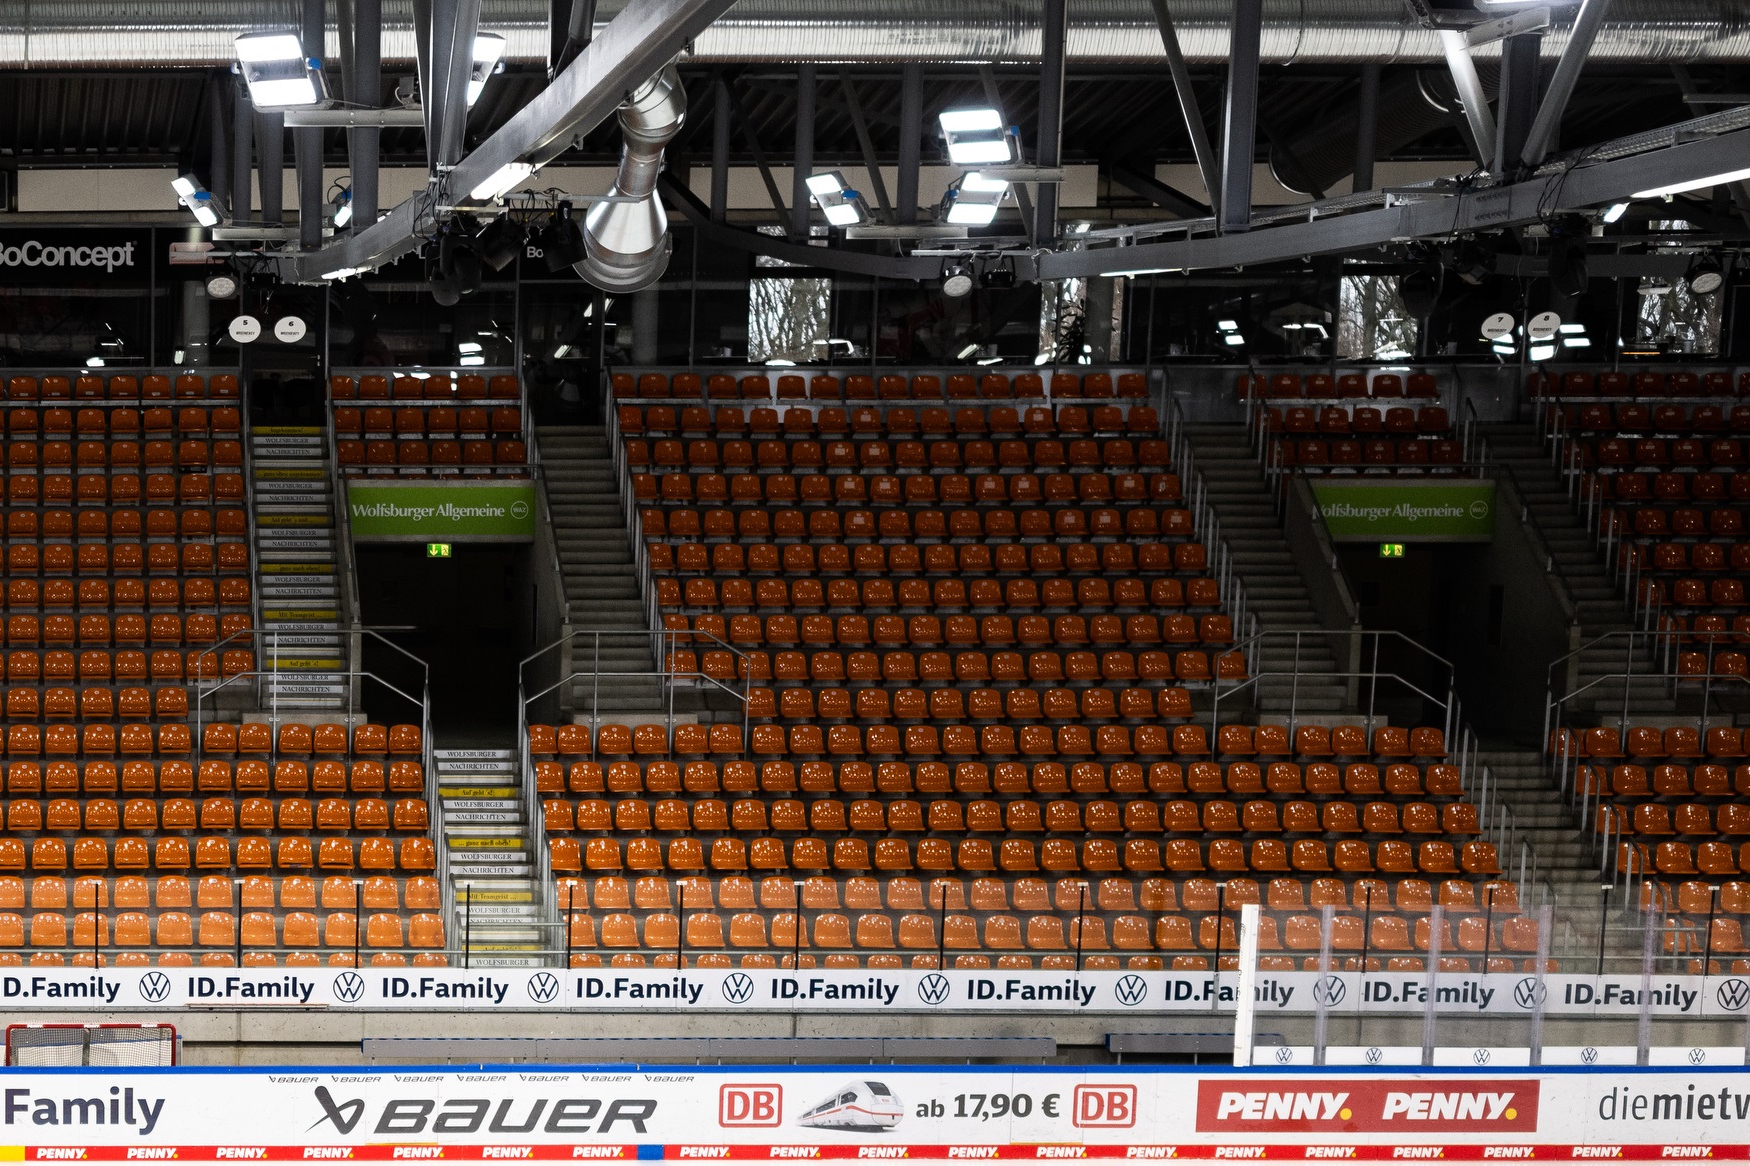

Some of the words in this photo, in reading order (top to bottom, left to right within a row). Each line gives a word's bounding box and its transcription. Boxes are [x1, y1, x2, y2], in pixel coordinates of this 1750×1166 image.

[352, 502, 434, 520] Wolfsburger
[436, 502, 505, 520] Allgemeine
[512, 506, 526, 514] WAZ
[1392, 503, 1464, 521] Allgemeine
[189, 976, 314, 1003] ID.Family
[383, 976, 508, 1004] ID.Family
[578, 977, 703, 1004] ID.Family
[772, 978, 899, 1005] ID.Family
[968, 978, 1096, 1006] ID.Family
[1365, 981, 1495, 1009] ID.Family
[1565, 984, 1697, 1012] ID.Family
[374, 1098, 658, 1134] BAUER
[726, 1090, 776, 1120] DB
[916, 1098, 945, 1119] ab
[954, 1093, 1033, 1122] 17,90
[1041, 1094, 1061, 1119] €
[1080, 1090, 1130, 1120] DB
